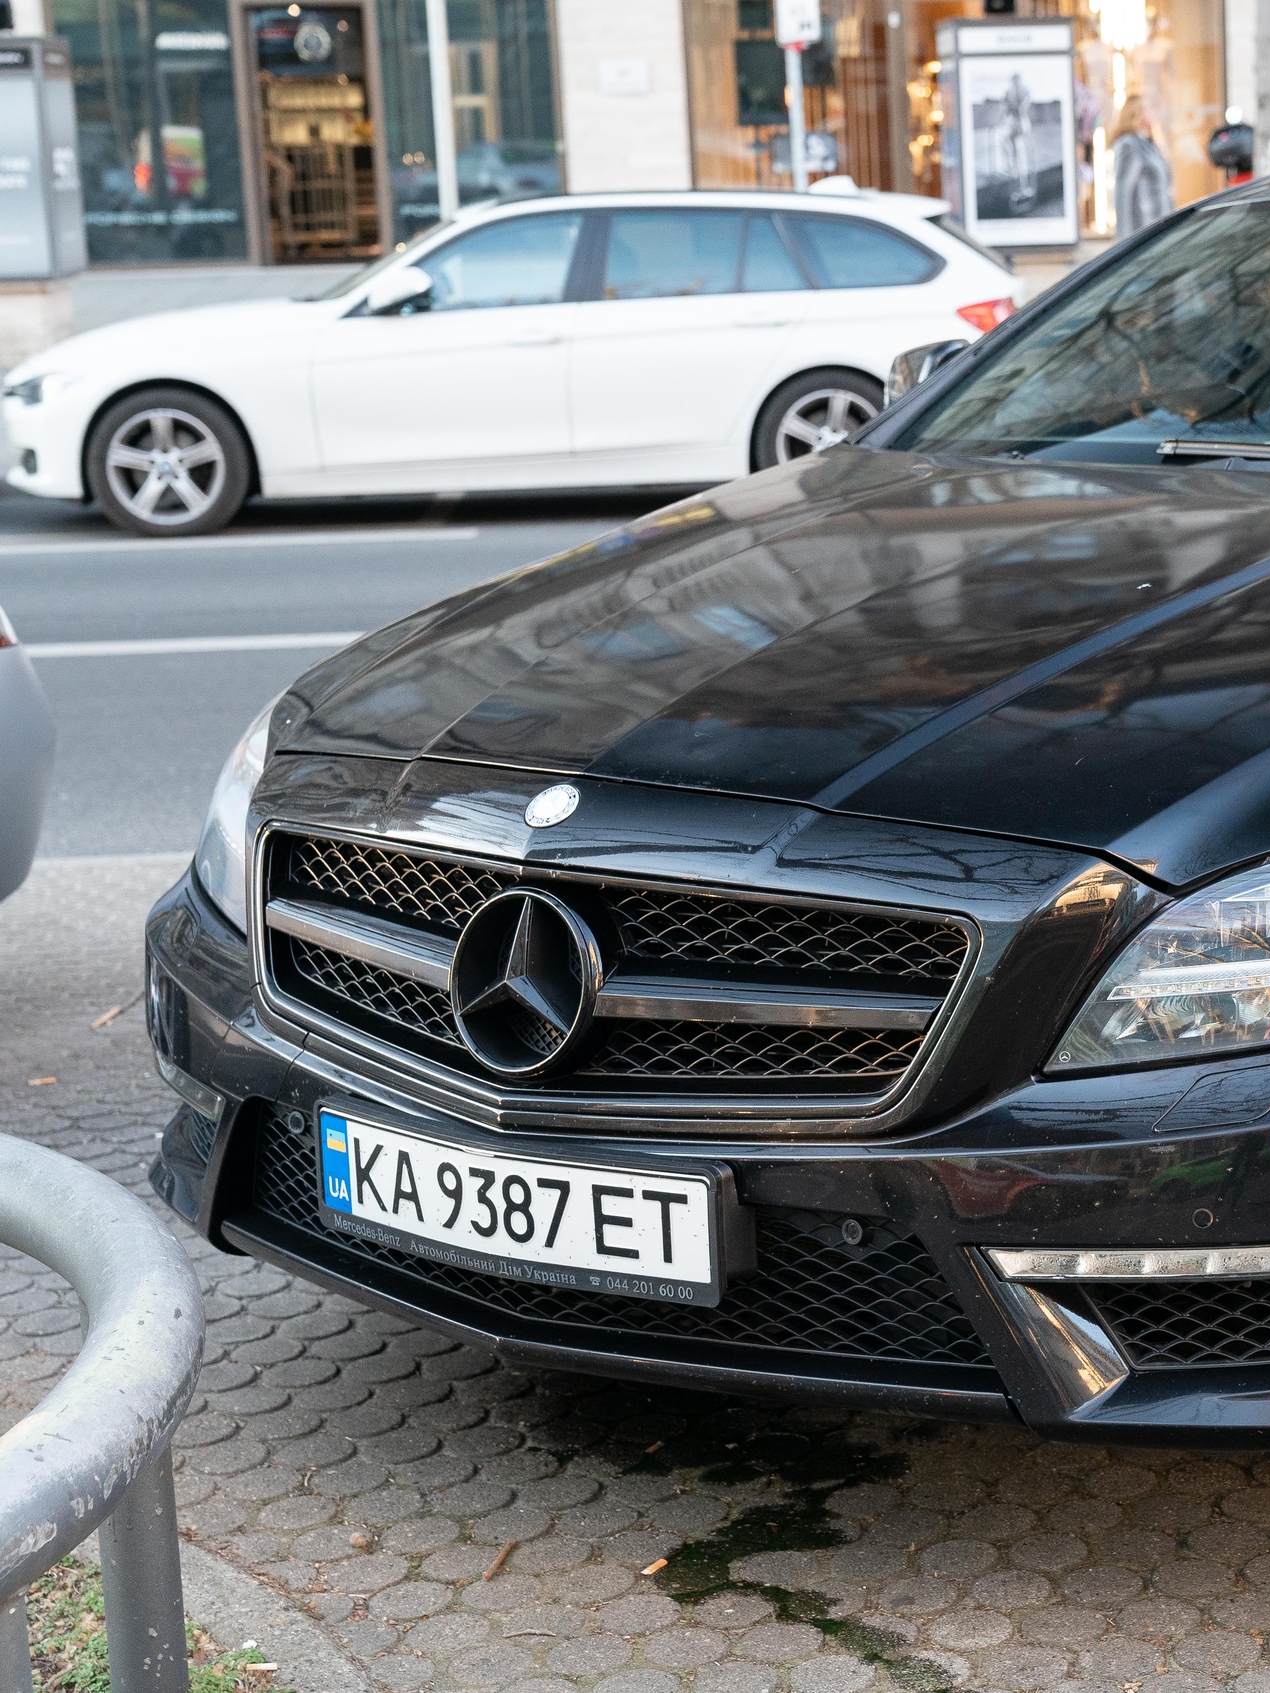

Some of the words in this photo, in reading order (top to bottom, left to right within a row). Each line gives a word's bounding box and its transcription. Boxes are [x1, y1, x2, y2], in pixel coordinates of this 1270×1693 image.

[328, 1176, 350, 1202] UA
[353, 1136, 425, 1223] KA
[436, 1161, 571, 1249] 9387
[591, 1183, 688, 1264] ET
[333, 1213, 401, 1248] Mercedes-Benz
[410, 1239, 496, 1273] Автомобільний
[499, 1260, 523, 1278] Дім
[523, 1264, 577, 1286] Україна
[606, 1276, 630, 1292] 044
[632, 1280, 655, 1295] 201
[658, 1283, 675, 1298] 60
[677, 1286, 694, 1301] 00
